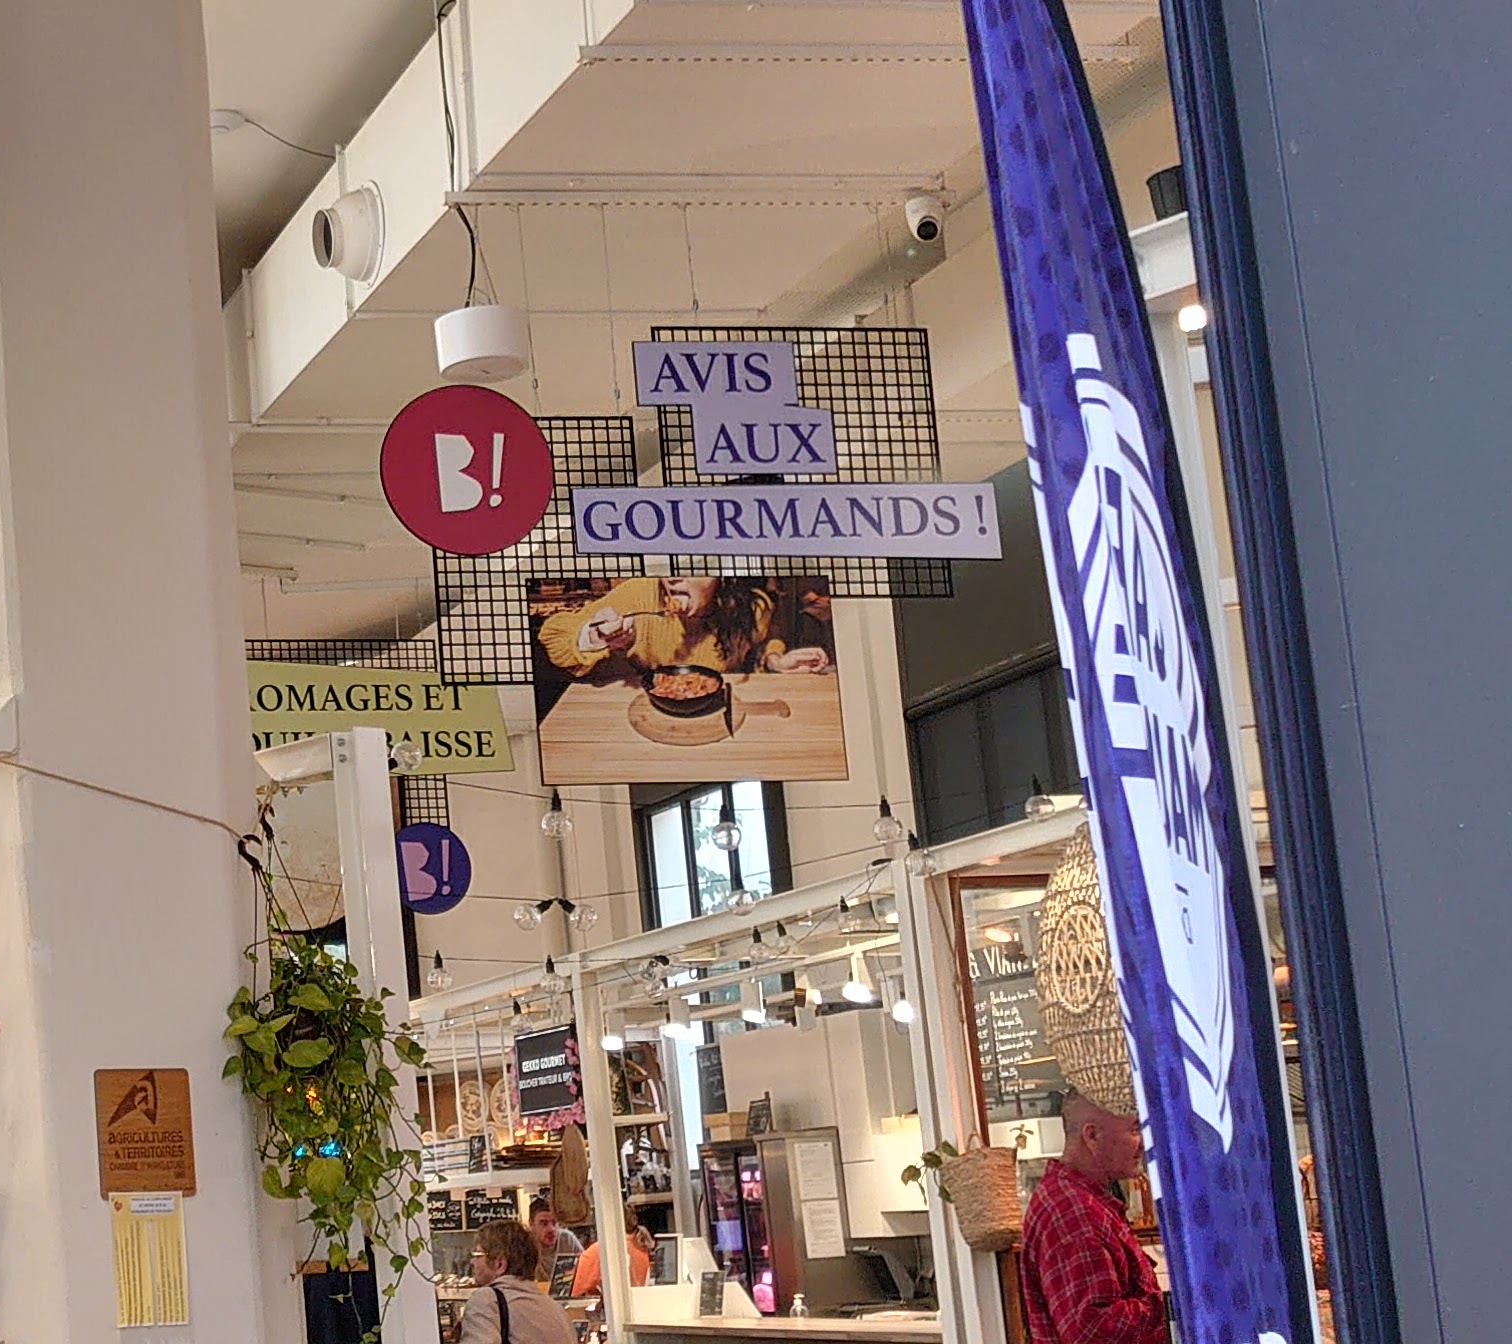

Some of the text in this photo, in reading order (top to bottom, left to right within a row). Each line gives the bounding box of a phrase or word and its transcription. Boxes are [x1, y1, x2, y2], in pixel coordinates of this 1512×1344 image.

[649, 351, 774, 394] AVIS
[705, 422, 827, 465] AUX
[582, 494, 962, 543] GOURMANDS
[250, 683, 469, 713] OMAGES ET
